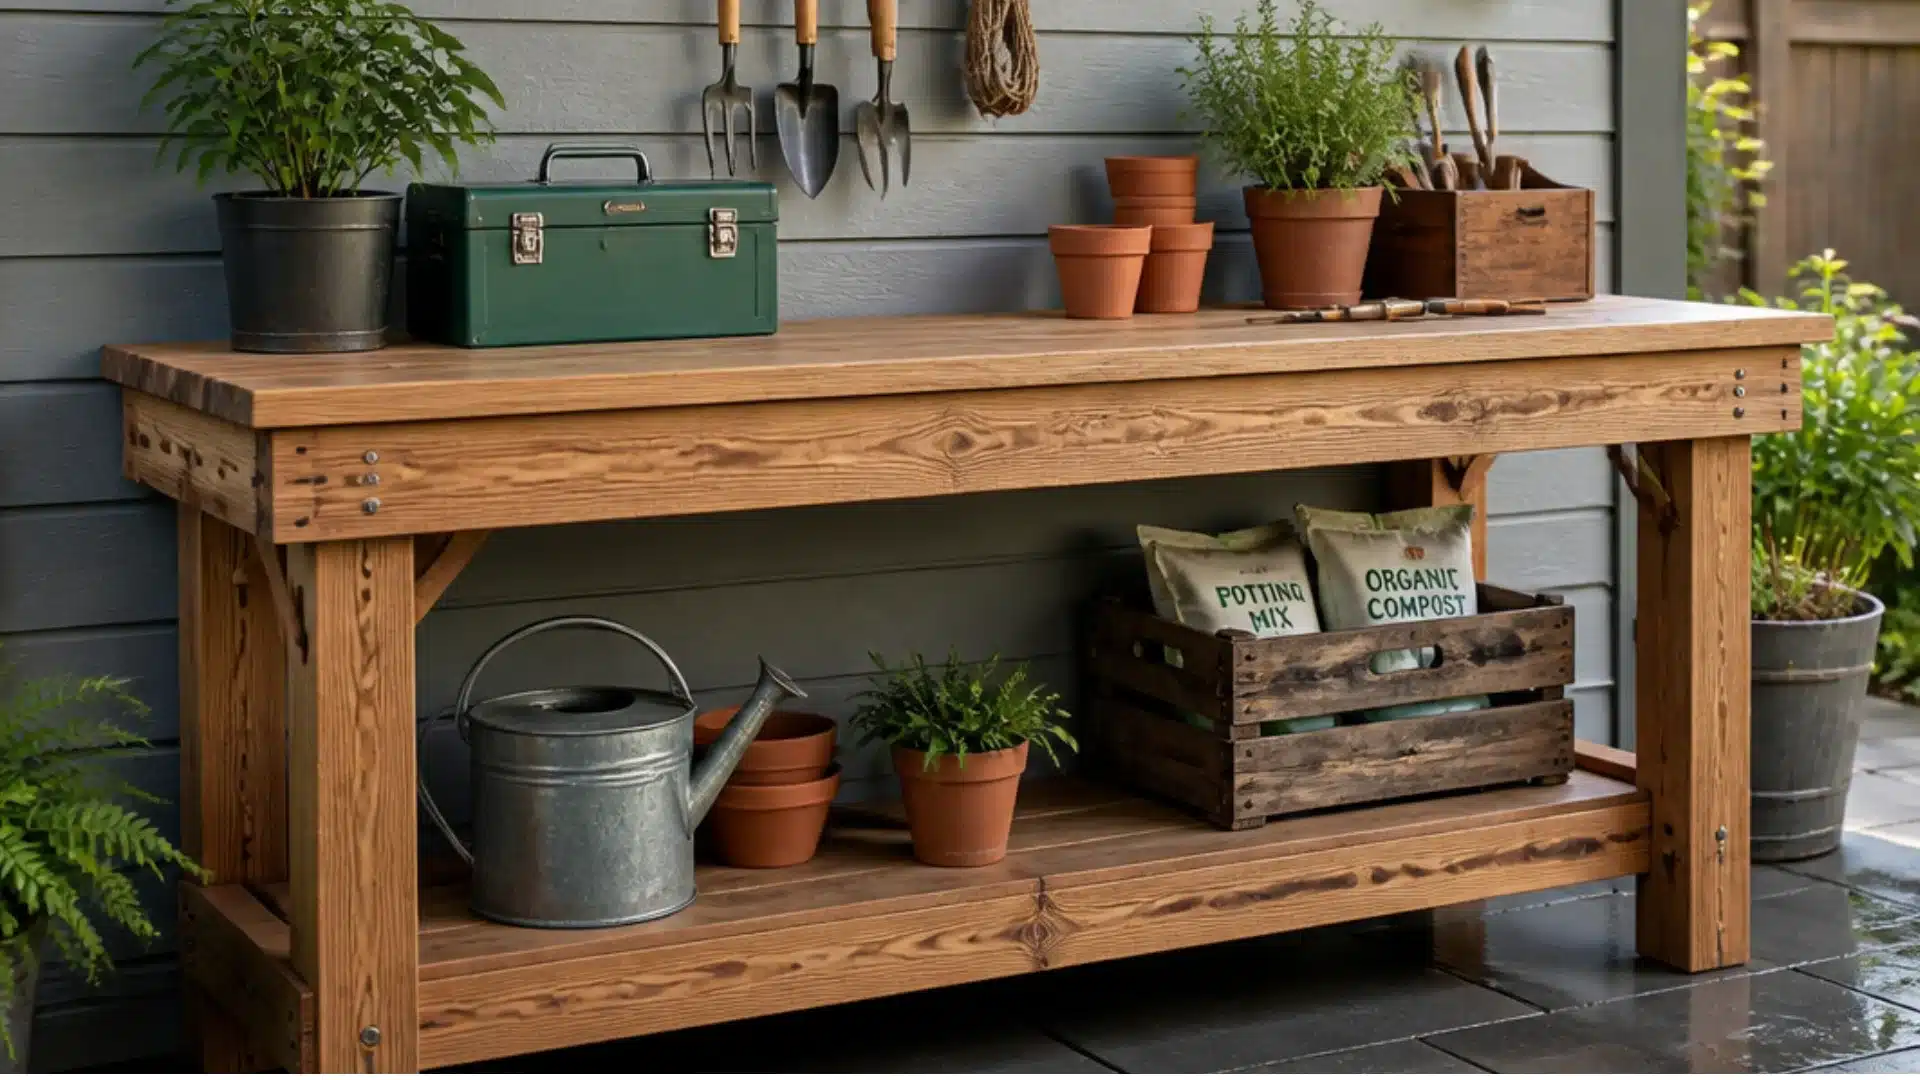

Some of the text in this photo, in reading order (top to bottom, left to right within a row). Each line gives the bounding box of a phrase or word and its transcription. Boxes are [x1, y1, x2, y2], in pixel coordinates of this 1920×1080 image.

[1366, 568, 1459, 592] ORGANIC
[1249, 606, 1293, 633] MIX
[1367, 594, 1466, 620] COMPOST
